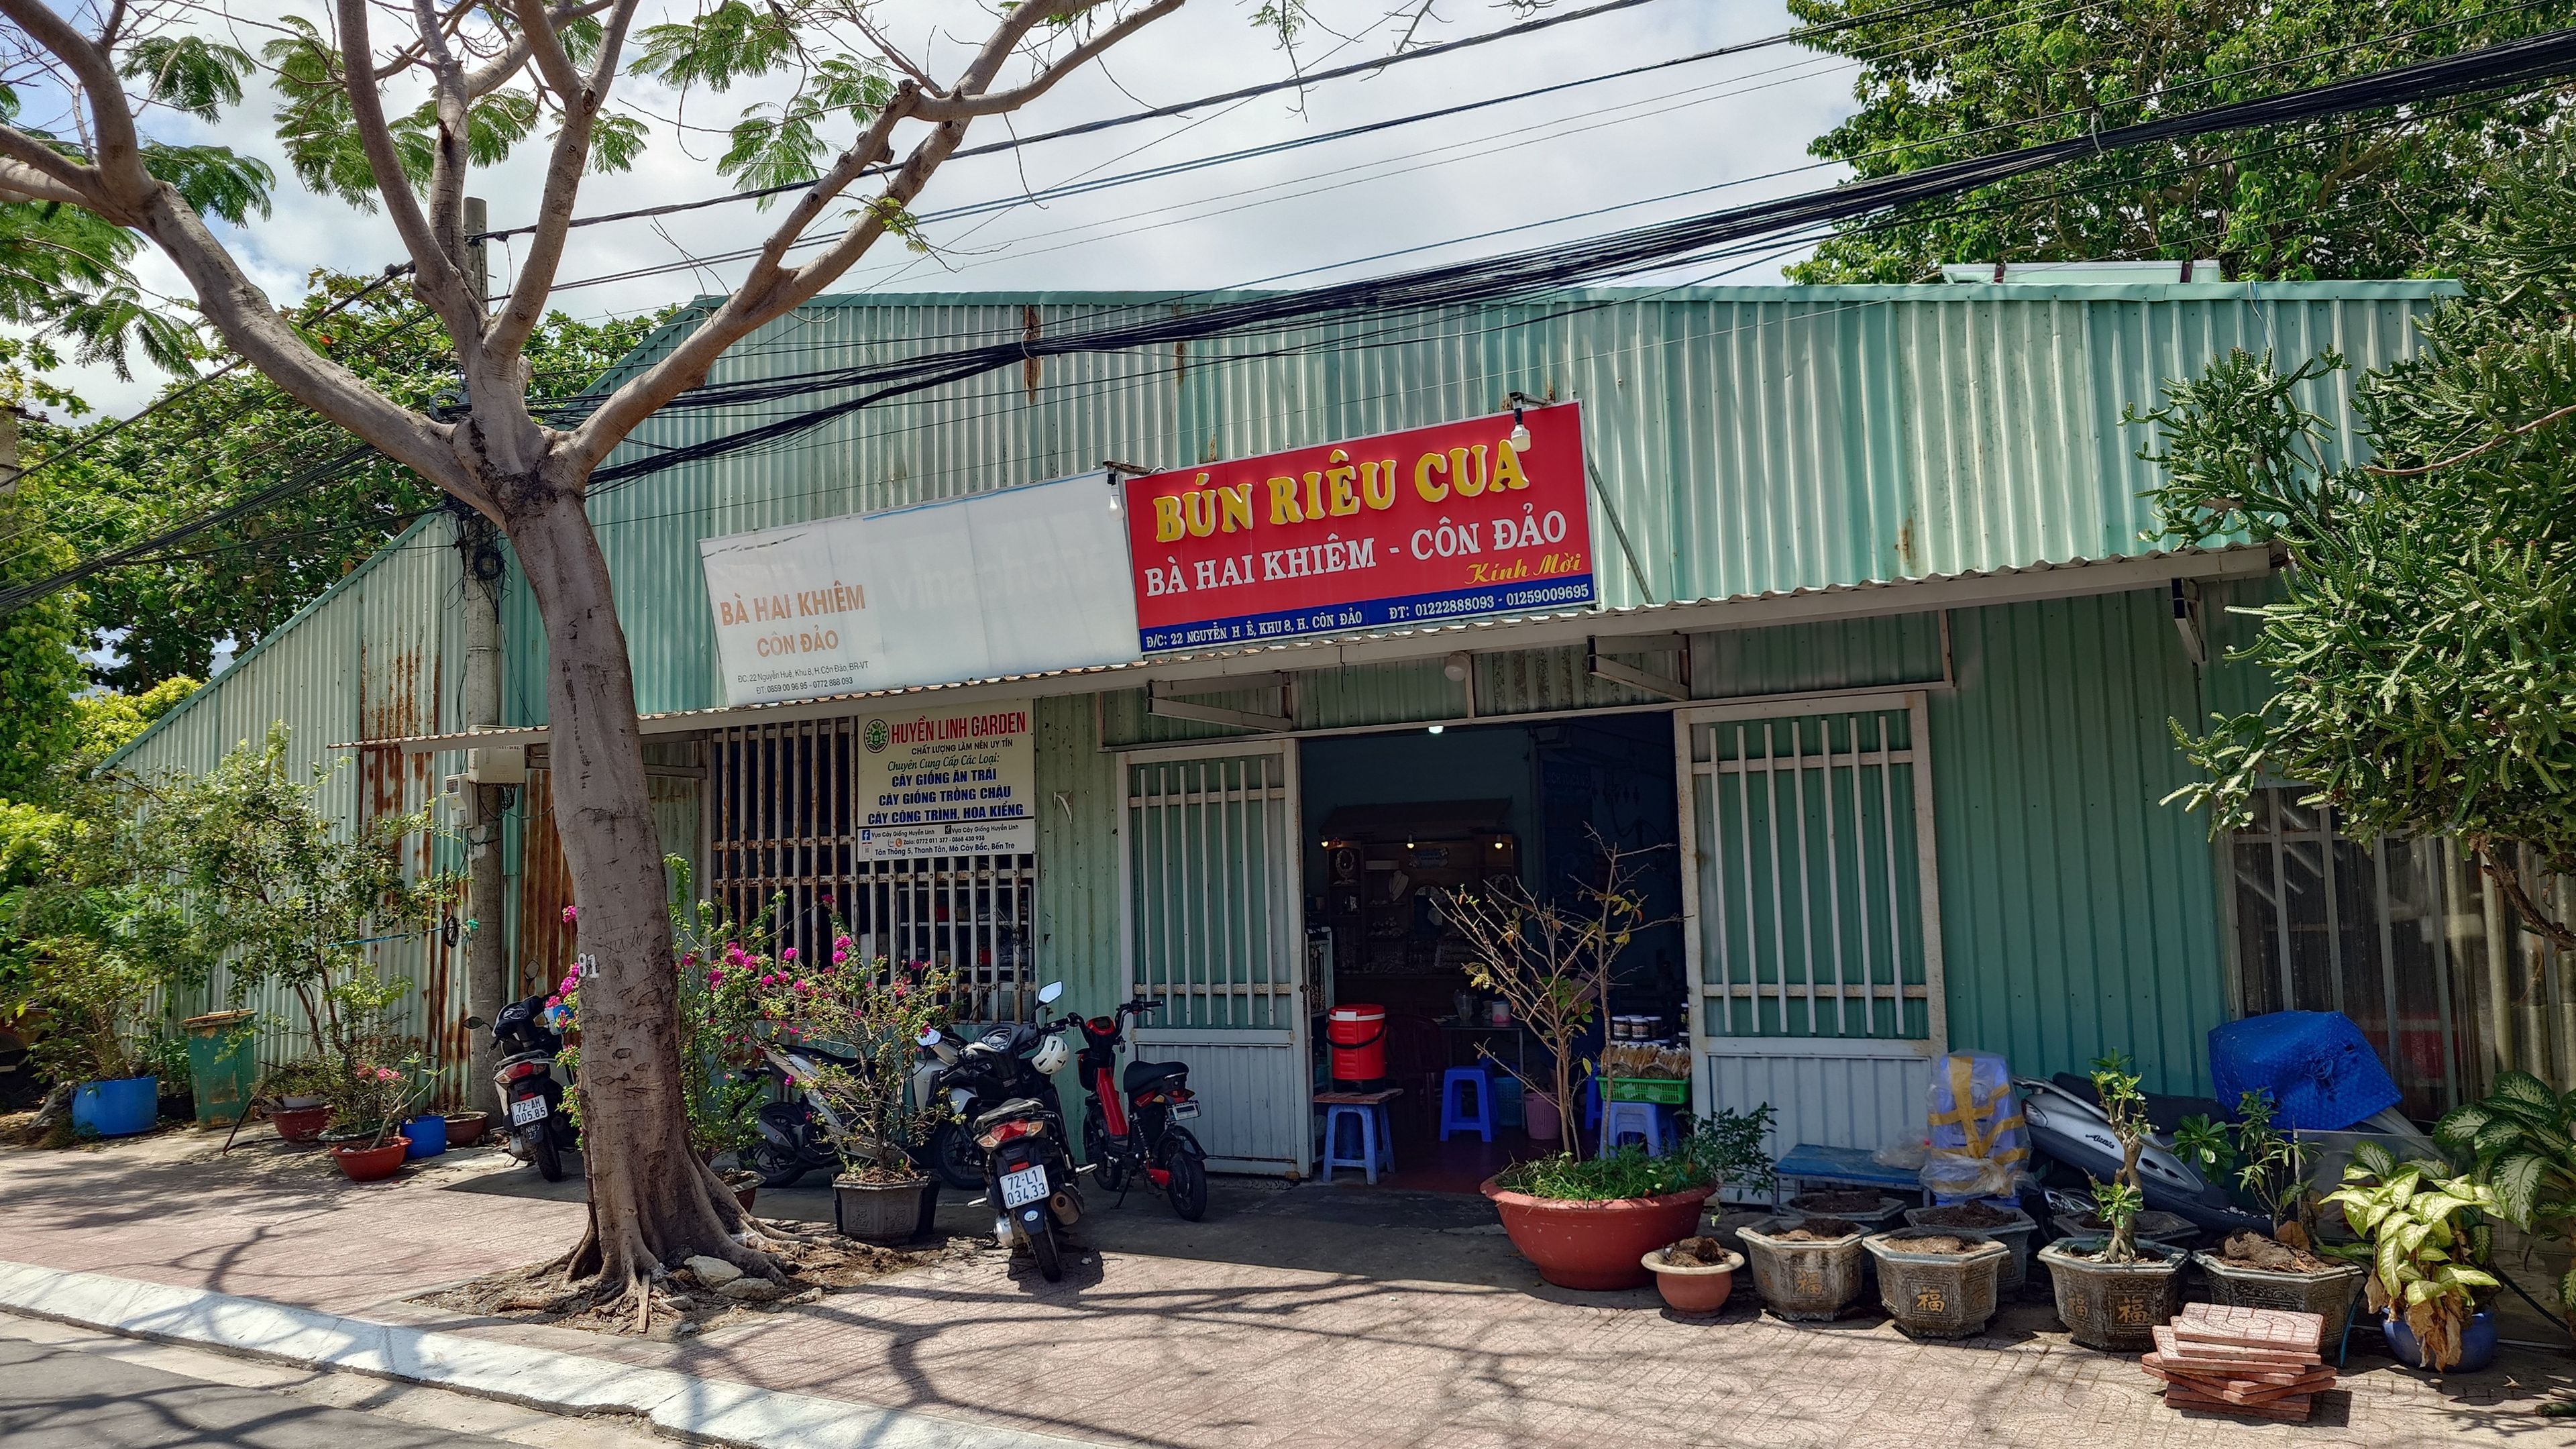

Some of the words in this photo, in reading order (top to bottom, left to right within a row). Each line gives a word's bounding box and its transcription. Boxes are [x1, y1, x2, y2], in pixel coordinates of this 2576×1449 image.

[1153, 472, 1253, 542] BÚN
[1267, 447, 1397, 525] RIÊU
[1414, 439, 1530, 503] CUA
[1144, 556, 1188, 596] BÀ
[1194, 554, 1254, 589] HAI
[1263, 533, 1377, 582] KHIÊM
[1411, 516, 1480, 560] CÔN
[1491, 502, 1567, 551] ĐẢO
[1464, 561, 1527, 585] Kính
[1537, 553, 1582, 575] Mời
[720, 592, 749, 627] BÀ
[753, 595, 792, 623] HAI
[796, 580, 867, 617] KHIÊM
[1146, 633, 1167, 648] Đ/C:
[1171, 633, 1183, 645] 22
[1258, 621, 1282, 635] KHU
[1284, 619, 1295, 633] 8,
[1296, 617, 1309, 631] H.
[1312, 611, 1334, 629] CÔN
[1339, 606, 1362, 626] ĐẢO
[1389, 606, 1410, 620] ĐT:
[1415, 594, 1495, 618] 01222888093
[1505, 582, 1589, 606] 01259009695
[757, 631, 796, 658] CÔN
[798, 624, 839, 653] ĐẢO
[749, 674, 757, 682] 22
[795, 669, 807, 677] Khu
[849, 660, 869, 671] BR-VT
[767, 684, 782, 693] 0859
[782, 683, 790, 692] 00
[791, 682, 799, 691] 96
[800, 682, 808, 690] 95
[813, 680, 828, 688] 0772
[828, 678, 841, 686] 888
[841, 676, 853, 685] 093
[891, 715, 934, 744] HUYỀN
[938, 717, 967, 740] LINH
[971, 711, 1026, 737] GARDEN
[911, 745, 930, 755] CHẤT
[932, 743, 956, 755] LƯỢNG
[958, 741, 973, 753] LÀM
[974, 741, 989, 750] NÊN
[990, 740, 1000, 749] UY
[1001, 737, 1013, 748] TÍN
[887, 758, 918, 773] Chuyên
[919, 757, 941, 770] Cung
[943, 753, 959, 768] Cấp
[961, 754, 977, 765] Các
[978, 751, 1000, 766] Loại:
[892, 774, 912, 788] CÂY
[916, 769, 950, 786] GIỐNG
[953, 769, 967, 783] ĂN
[970, 767, 997, 782] TRÁI
[878, 793, 900, 806] CÂY
[902, 788, 936, 805] GIỐNG
[939, 786, 977, 802] TRỒNG
[979, 784, 1012, 802] CHẬU
[867, 812, 888, 825] CÂY
[891, 809, 921, 823] CÔNG
[924, 807, 960, 822] TRÌNH,
[963, 805, 986, 819] HOA
[989, 800, 1024, 817] KIỂNG
[893, 829, 908, 837] Giống
[974, 825, 989, 833] Giống
[888, 847, 906, 857] Thông
[914, 846, 933, 854] Thanh
[991, 841, 1004, 850] Bến
[578, 952, 600, 979] 81
[515, 1106, 546, 1124] 005.85
[517, 1098, 541, 1113] 72-AH
[1008, 1169, 1038, 1190] 72-L1
[1007, 1182, 1046, 1205] 034.33
[1916, 1285, 1945, 1313] 福
[2118, 1295, 2147, 1324] 福
